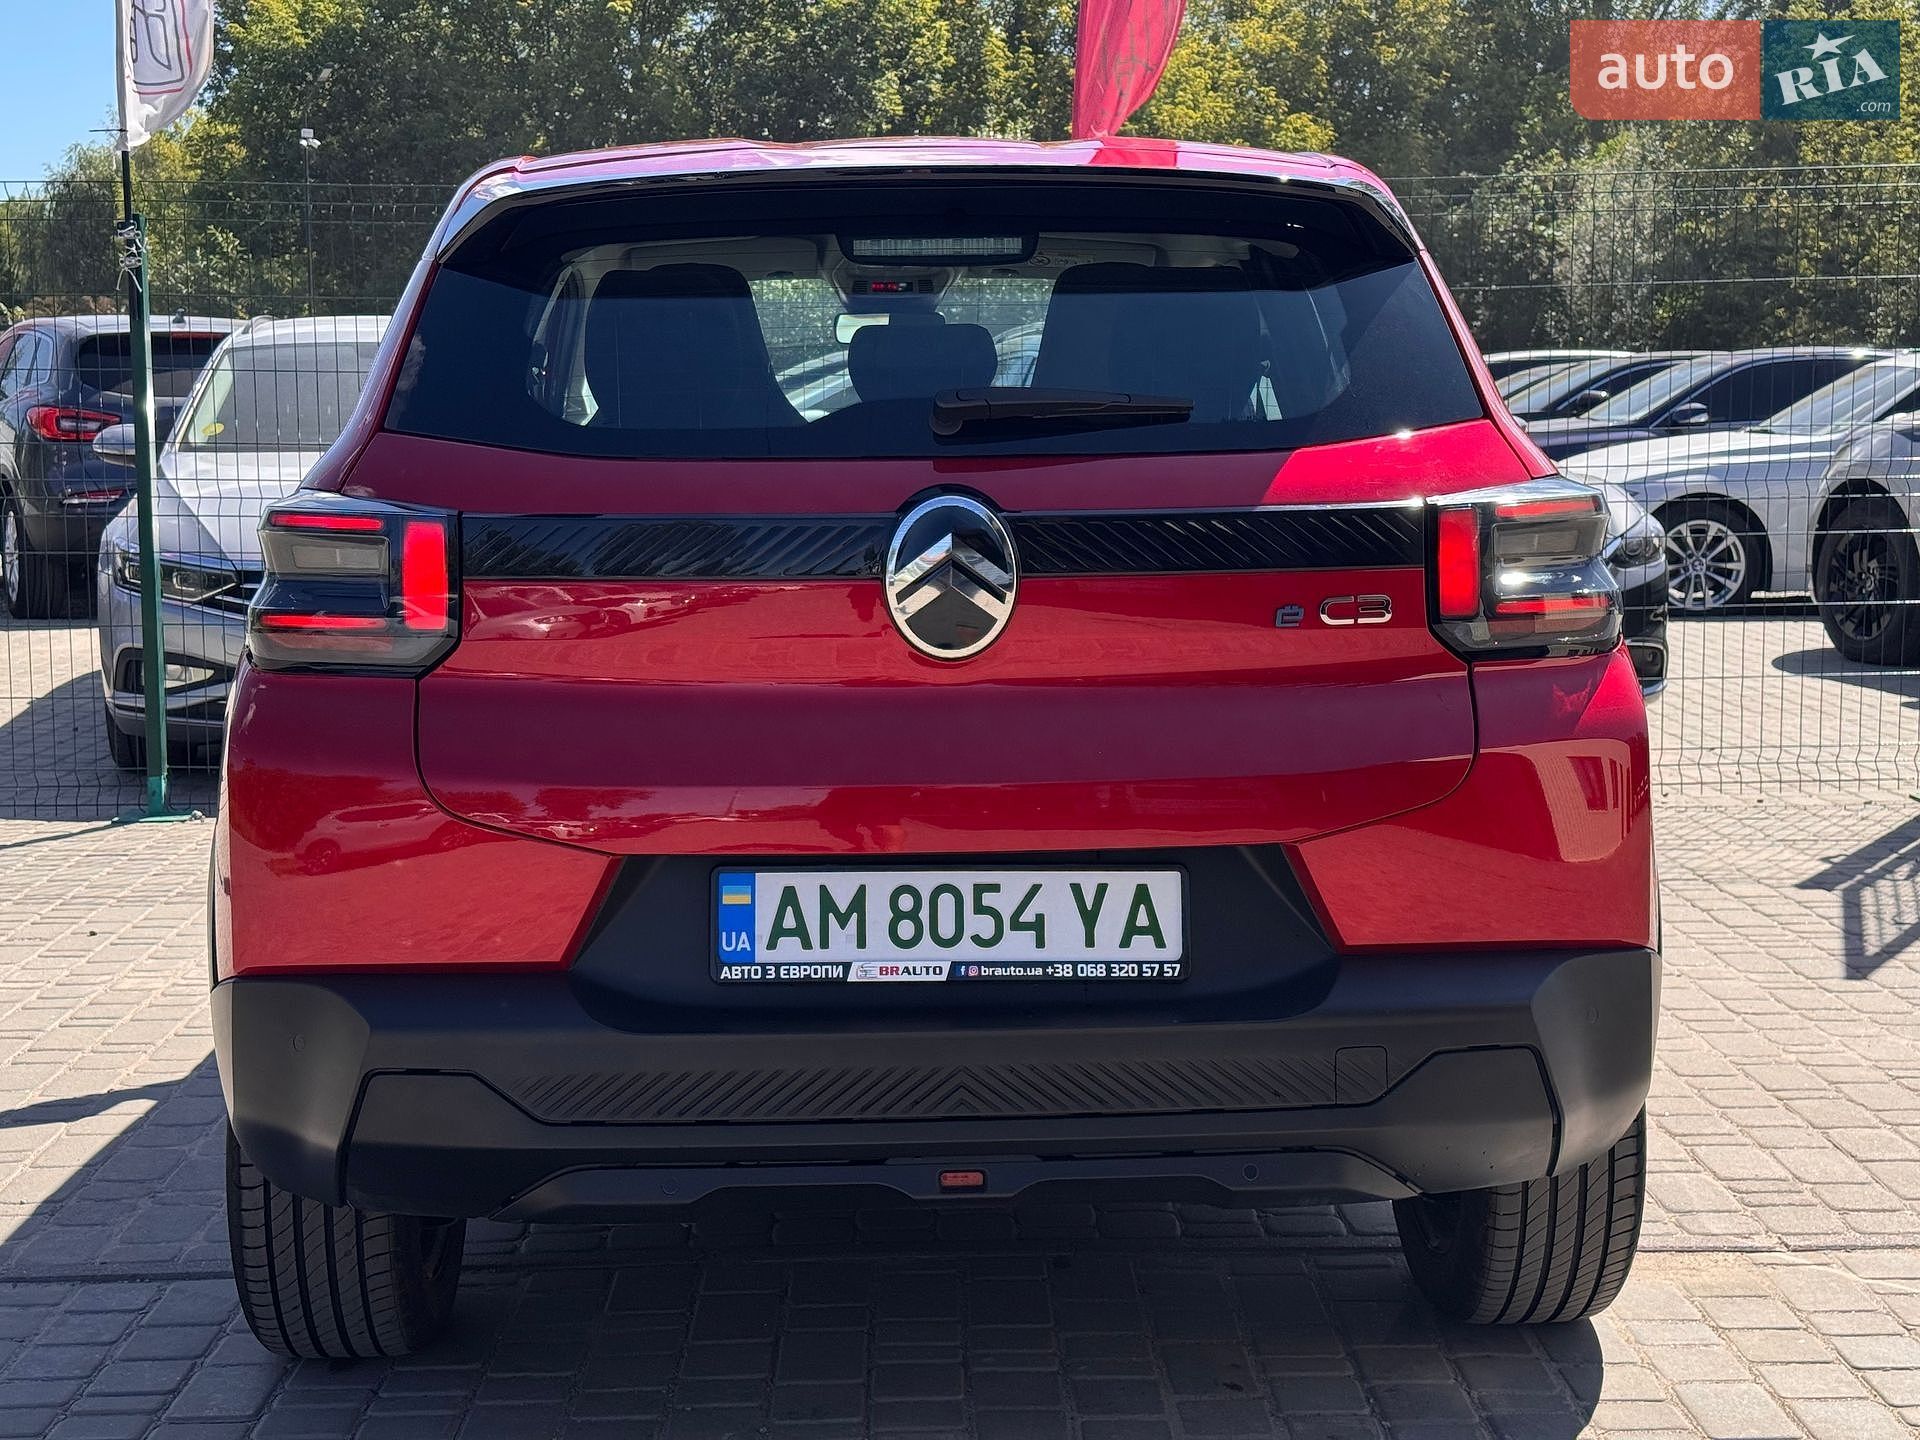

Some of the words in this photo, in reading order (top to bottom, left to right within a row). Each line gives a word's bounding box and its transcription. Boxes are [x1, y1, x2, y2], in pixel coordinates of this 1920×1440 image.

[1319, 594, 1393, 626] C3
[765, 884, 867, 951] AM
[887, 883, 1046, 950] 8054
[1069, 883, 1167, 949] YA
[722, 931, 751, 952] UA
[720, 966, 762, 980] АВТО
[879, 965, 943, 976] BRAUTO
[981, 965, 1043, 976] brauto.ua
[1046, 964, 1073, 977] +38
[1077, 964, 1107, 977] 068
[1110, 964, 1138, 977] 320
[1142, 964, 1160, 977] 57
[1163, 964, 1181, 977] 57
